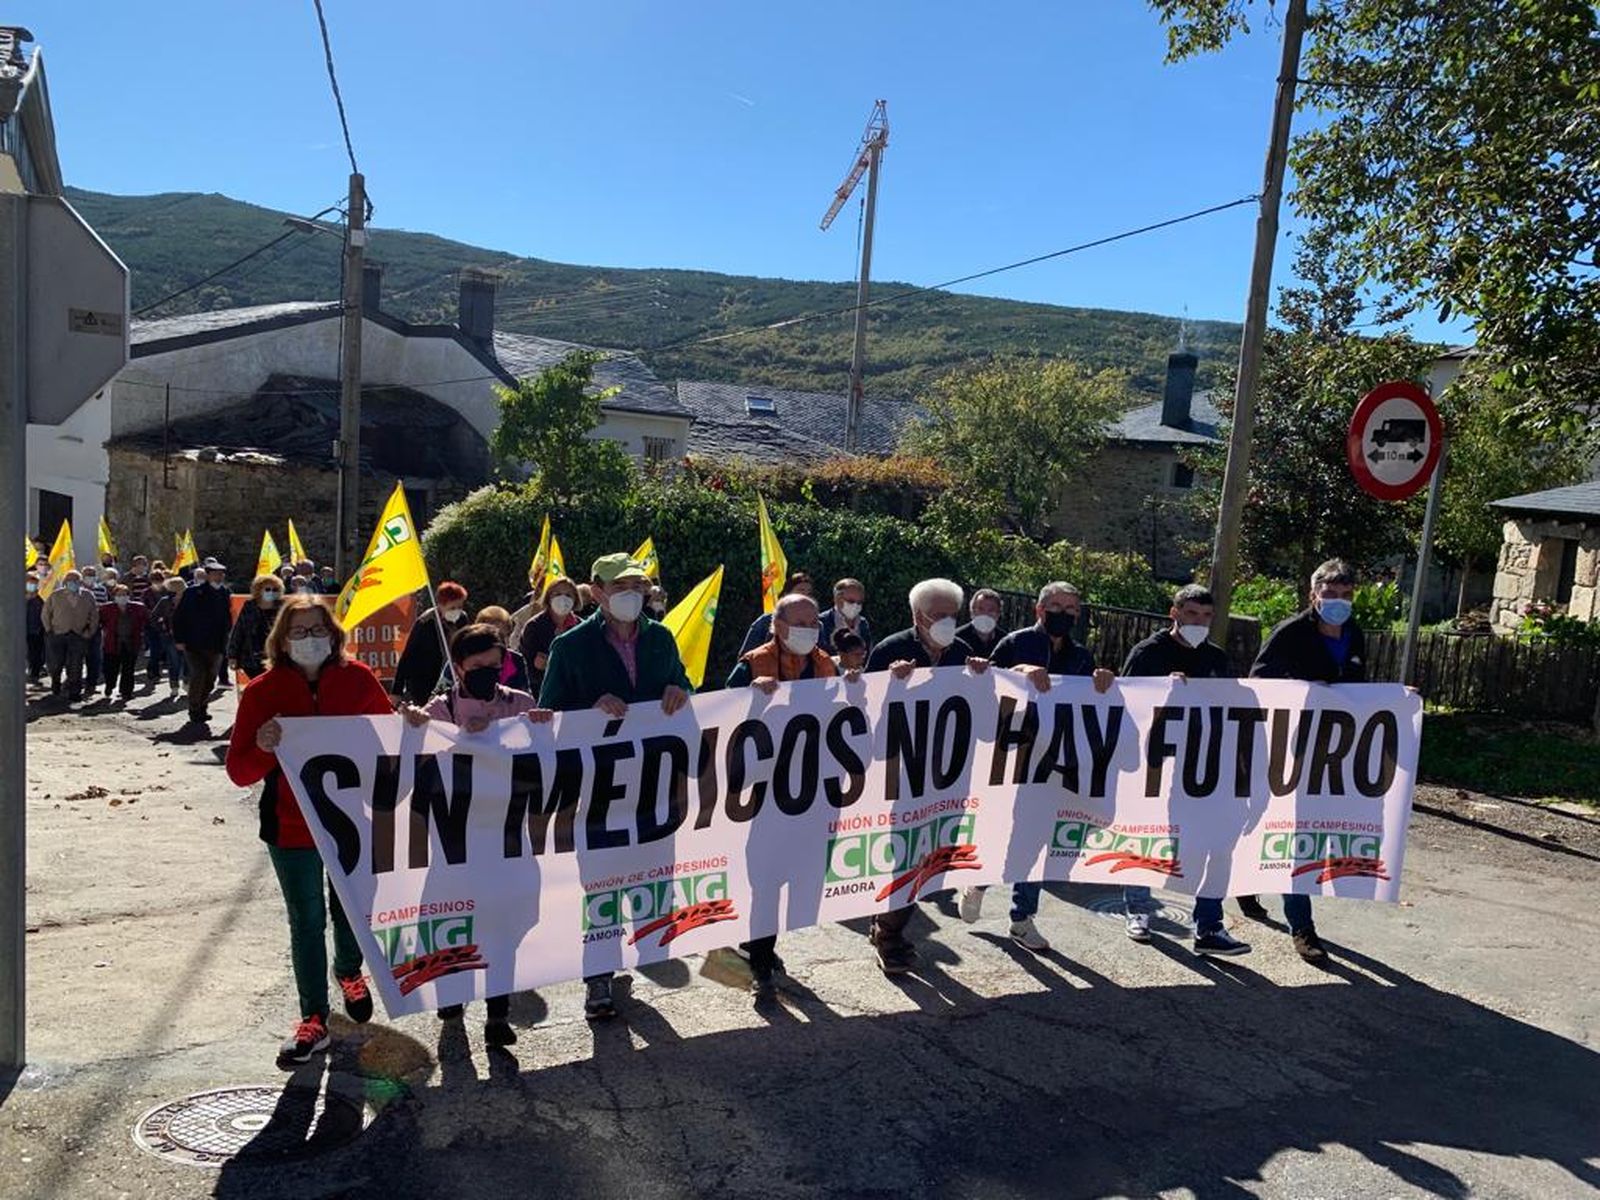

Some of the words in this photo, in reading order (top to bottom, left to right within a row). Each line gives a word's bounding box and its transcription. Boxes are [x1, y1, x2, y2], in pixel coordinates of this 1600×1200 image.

[381, 624, 401, 642] DE
[300, 753, 473, 876] SIN
[504, 705, 867, 858] MÉDICOS
[884, 695, 972, 800] NO
[988, 696, 1124, 798] HAY
[1145, 706, 1398, 798] FUTURO
[828, 812, 873, 834] UNIÓN
[877, 812, 897, 827] DE
[902, 797, 980, 824] CAMPESINOS
[1296, 820, 1311, 829] DE
[1312, 820, 1383, 832] CAMPESINOS
[1055, 822, 1177, 861] COAG
[1113, 824, 1181, 834] CAMPESINOS
[829, 815, 975, 879] COAG
[1050, 848, 1087, 859] ZAMORA
[1263, 833, 1378, 860] COAG
[628, 869, 644, 883] DE
[647, 855, 729, 881] CAMPESINOS
[1259, 861, 1292, 871] ZAMORA
[585, 874, 727, 926] COAG
[825, 880, 877, 899] ZAMORA
[377, 899, 475, 925] CAMPESINOS
[582, 926, 628, 944] ZAMORA
